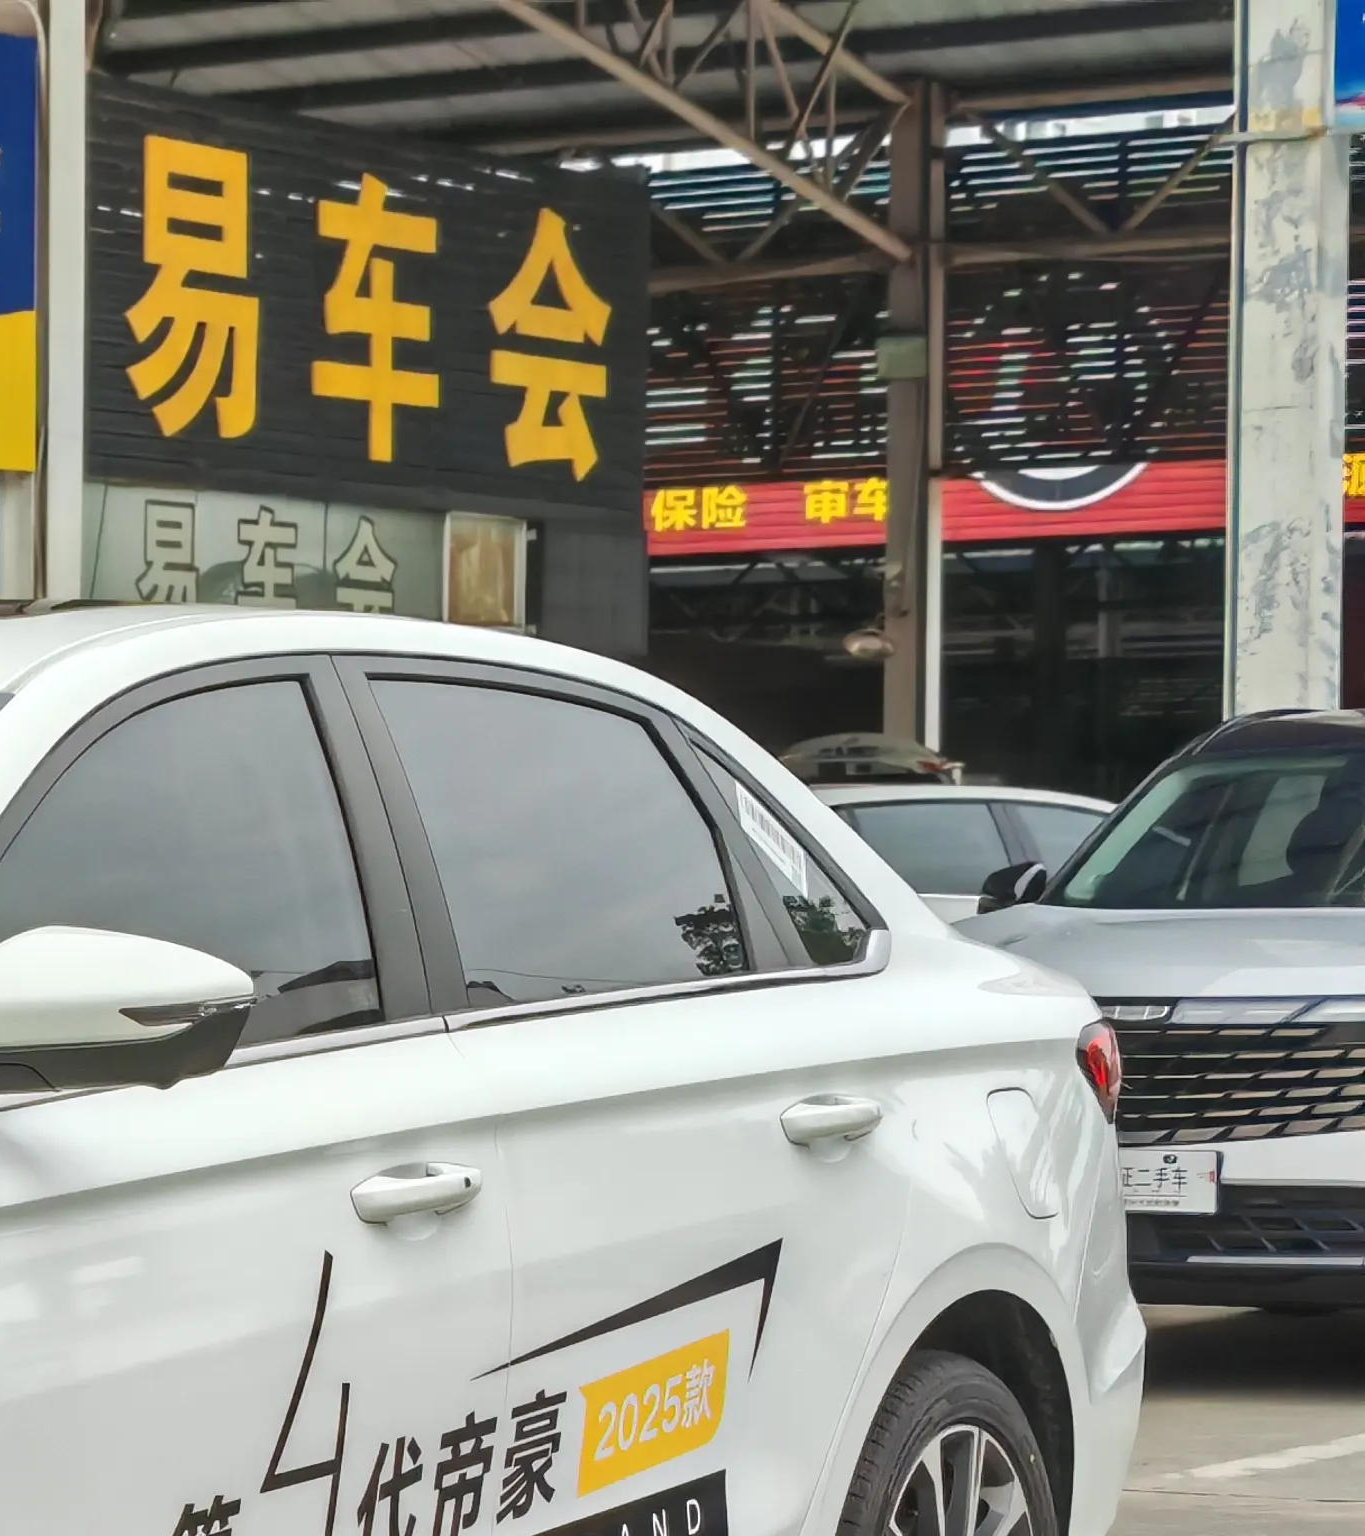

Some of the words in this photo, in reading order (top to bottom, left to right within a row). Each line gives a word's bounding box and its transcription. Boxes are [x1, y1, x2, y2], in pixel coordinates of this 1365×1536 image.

[124, 134, 612, 482] 易车会
[135, 499, 398, 613] 易车会
[651, 485, 747, 532] 保险
[804, 477, 889, 524] 审车
[594, 1358, 715, 1462] 2025款
